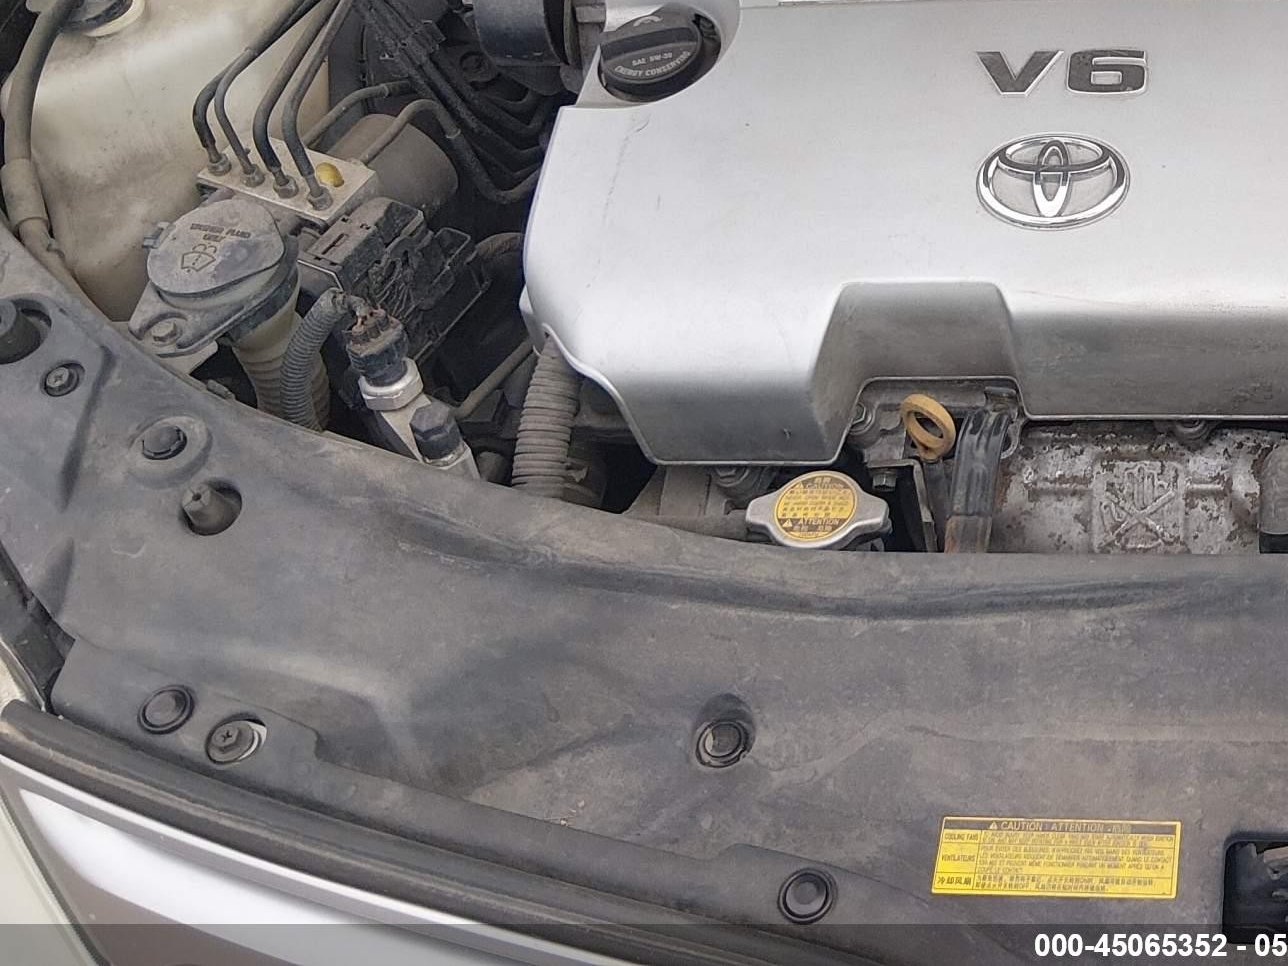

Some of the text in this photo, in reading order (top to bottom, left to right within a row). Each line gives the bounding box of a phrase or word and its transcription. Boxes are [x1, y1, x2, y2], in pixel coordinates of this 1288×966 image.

[976, 49, 1148, 96] V6
[798, 518, 840, 526] ATTENTION
[1000, 821, 1043, 831] CAUTION
[1050, 822, 1105, 832] ATTENTION
[944, 832, 965, 841] COOLING
[966, 833, 979, 842] FANS
[941, 854, 976, 863] VENTILATEURS
